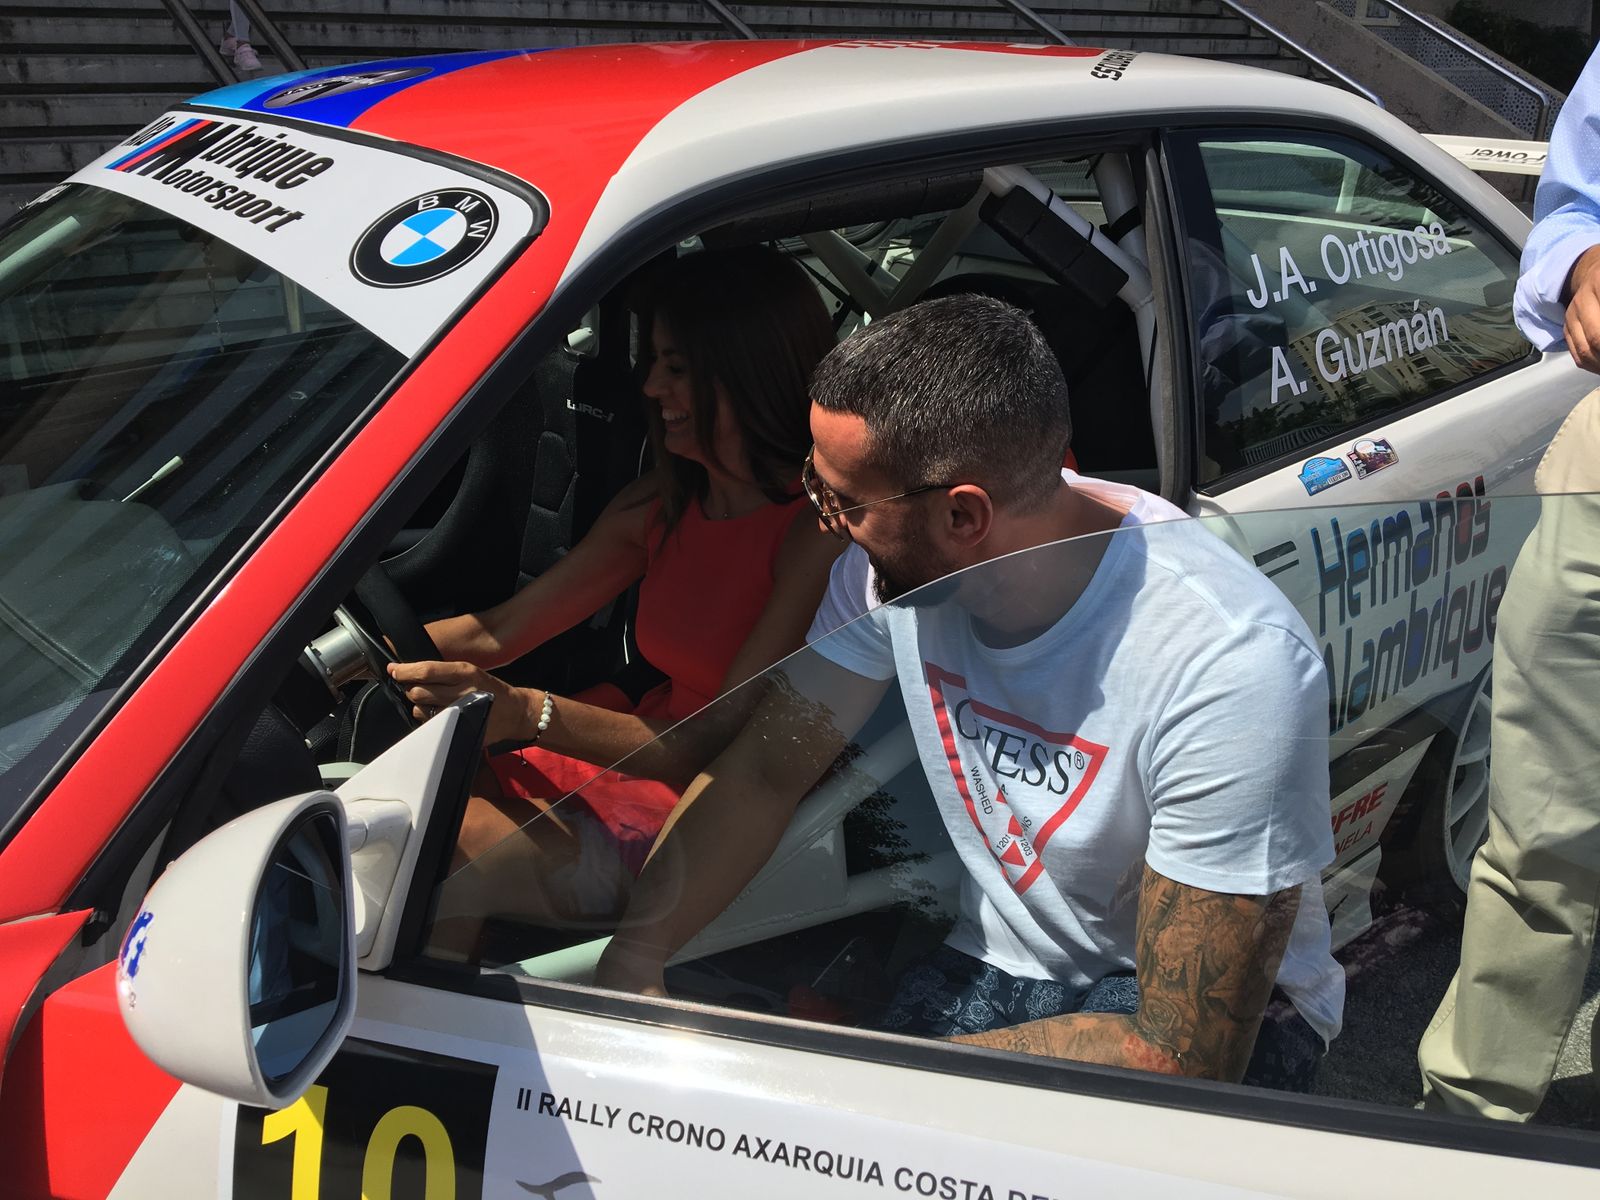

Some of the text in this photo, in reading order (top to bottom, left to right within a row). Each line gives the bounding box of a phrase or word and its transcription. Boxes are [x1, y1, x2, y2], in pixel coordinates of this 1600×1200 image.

[1246, 221, 1451, 309] J.A. Ortigosa
[1270, 299, 1449, 404] A. Guzmán
[1310, 475, 1491, 638] Hermanos
[969, 765, 994, 816] WASHED
[996, 834, 1011, 851] 1201
[538, 1092, 622, 1129] RALLY
[627, 1111, 726, 1152] CRONO
[732, 1134, 884, 1187] AXARQUIA
[893, 1166, 995, 1200] COSTA
